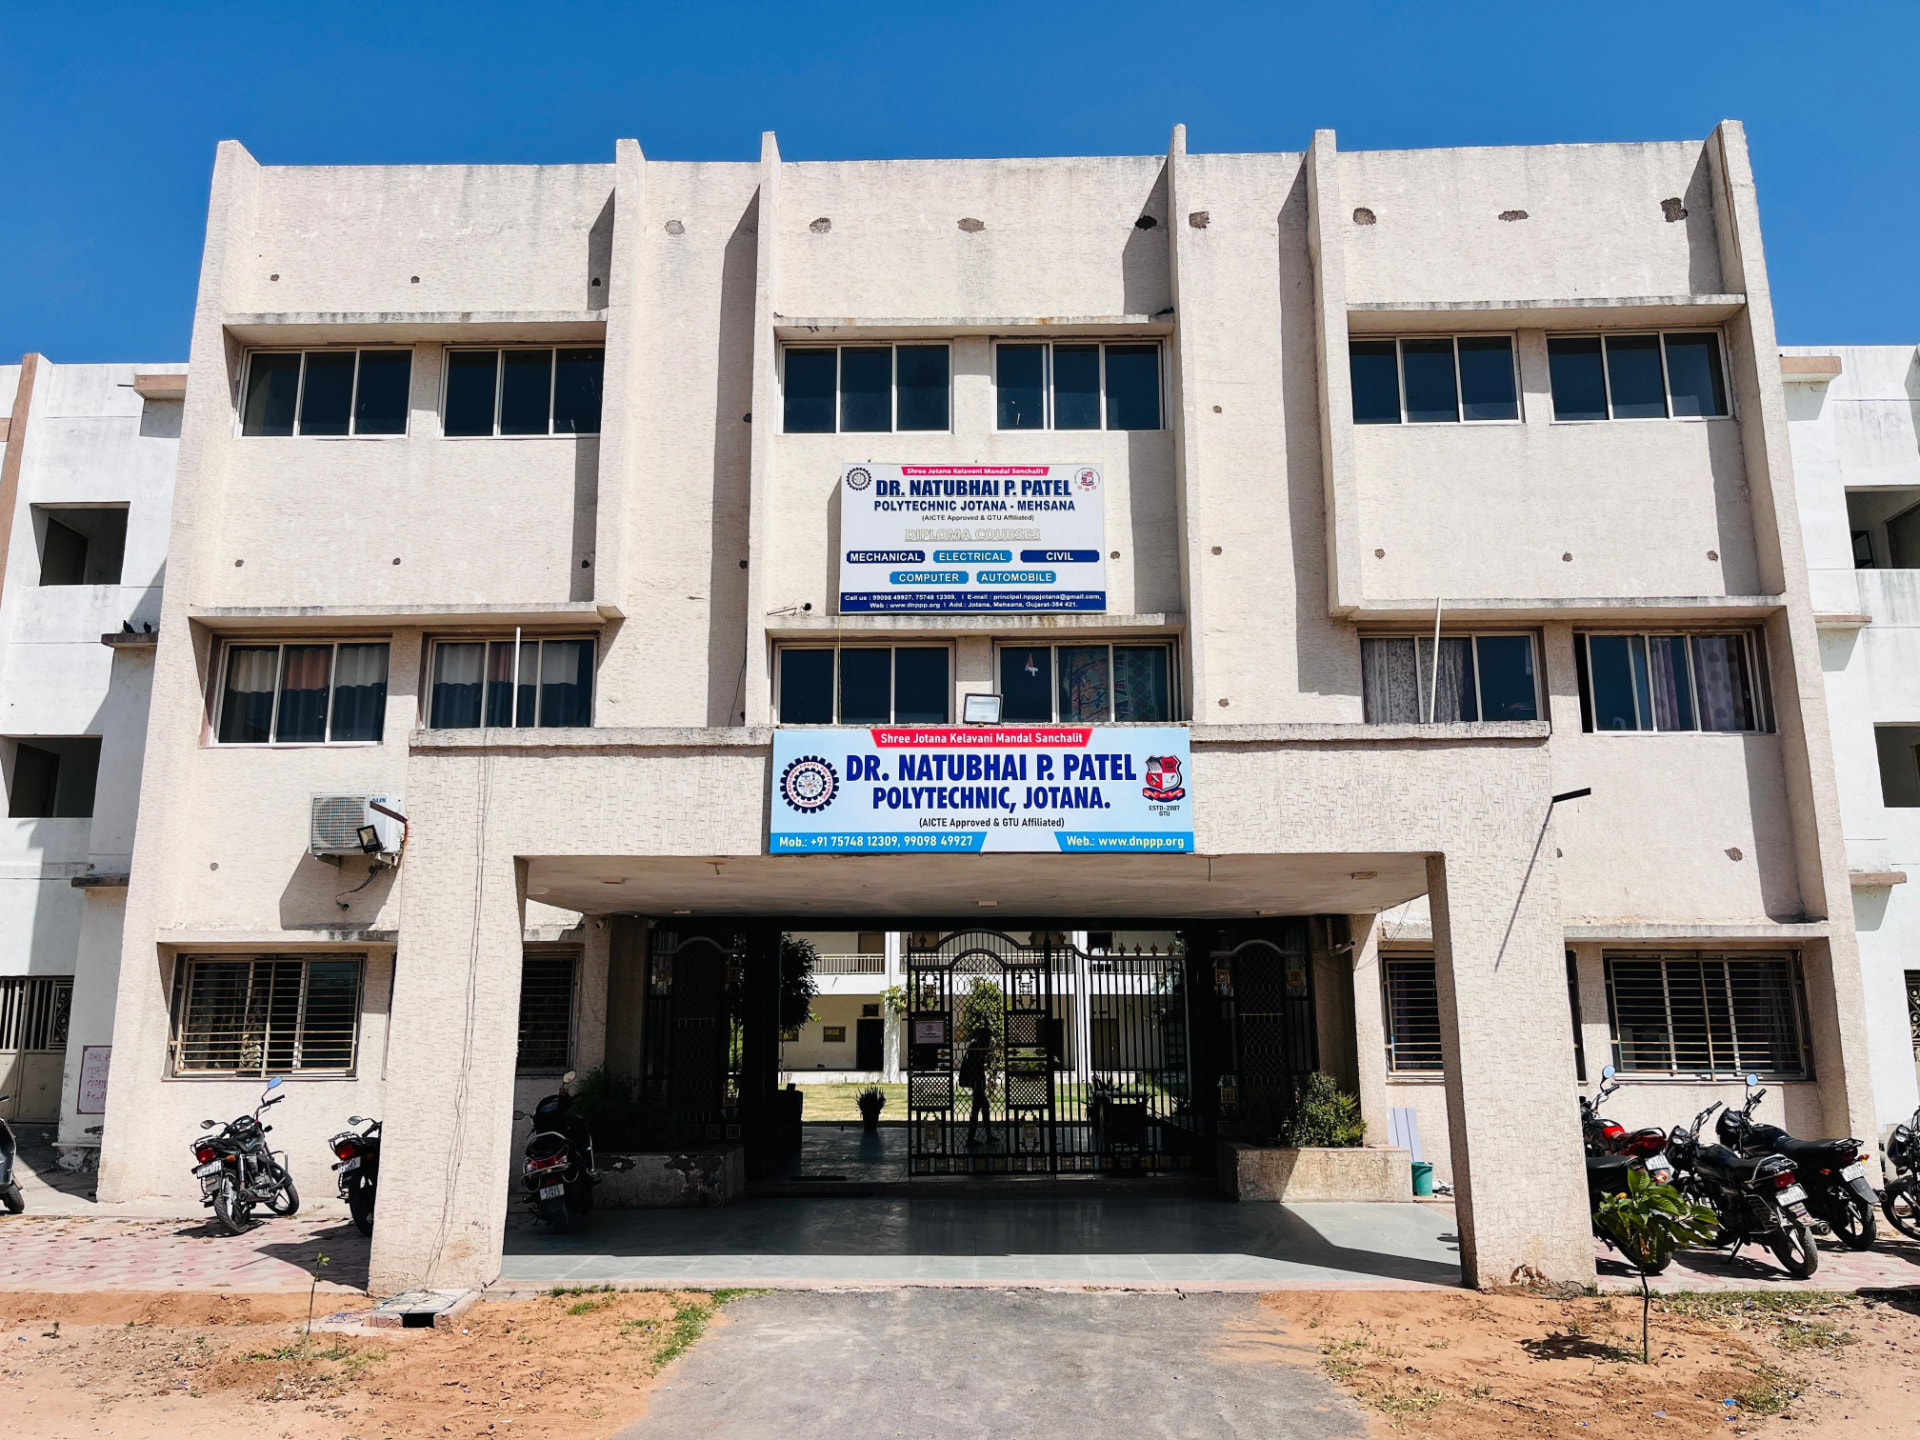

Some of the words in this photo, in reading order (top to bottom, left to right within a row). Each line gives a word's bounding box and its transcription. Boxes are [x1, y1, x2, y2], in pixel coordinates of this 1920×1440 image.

[906, 467, 928, 475] Shree
[953, 466, 983, 475] Kelavani
[984, 466, 1010, 475] Mandal
[1011, 466, 1044, 475] Sanchalit
[876, 480, 905, 497] DR.
[909, 480, 999, 497] NATUBHAI
[1004, 479, 1018, 497] P.
[1022, 479, 1072, 497] PATEL
[874, 501, 957, 512] POLYTECHNIC
[960, 500, 1007, 511] JOTANA
[1017, 500, 1075, 511] MEHSANA
[921, 514, 946, 522] (AICTE
[946, 514, 979, 523] Approved
[1003, 514, 1035, 522] Affiliated)
[904, 528, 972, 541] DIPLOMA
[975, 528, 1041, 541] COURSES
[850, 552, 922, 562] MECHANICAL
[939, 552, 1006, 561] ELECTRICAL
[1046, 551, 1074, 561] CIVIL
[898, 573, 960, 582] COMPUTER
[980, 572, 1052, 582] AUTOMOBILE
[880, 733, 911, 744] Shree
[913, 733, 947, 744] Jotana
[949, 733, 993, 744] Kelavani
[995, 732, 1033, 743] Mandal
[1035, 732, 1083, 743] Sanchalit
[846, 755, 890, 782] DR.
[898, 755, 1028, 781] NATUBHAI
[1036, 755, 1055, 780] P.
[1062, 754, 1137, 780] PATEL
[872, 787, 1017, 814] POLYTECHNIC,
[1023, 786, 1111, 810] JOTANA.
[919, 818, 948, 828] (AICTE
[949, 818, 991, 829] Approved
[993, 818, 1000, 827] &
[1002, 818, 1019, 827] GTU
[1021, 817, 1065, 828] Affiliated)
[779, 836, 807, 848] Mob.:
[810, 836, 828, 847] +91
[830, 836, 864, 847] 75748
[866, 836, 901, 849] 12309,
[903, 836, 937, 847] 99098
[940, 836, 973, 847] 49927
[1066, 835, 1095, 847] Web.:
[1098, 836, 1185, 850] www.dnppp.org
